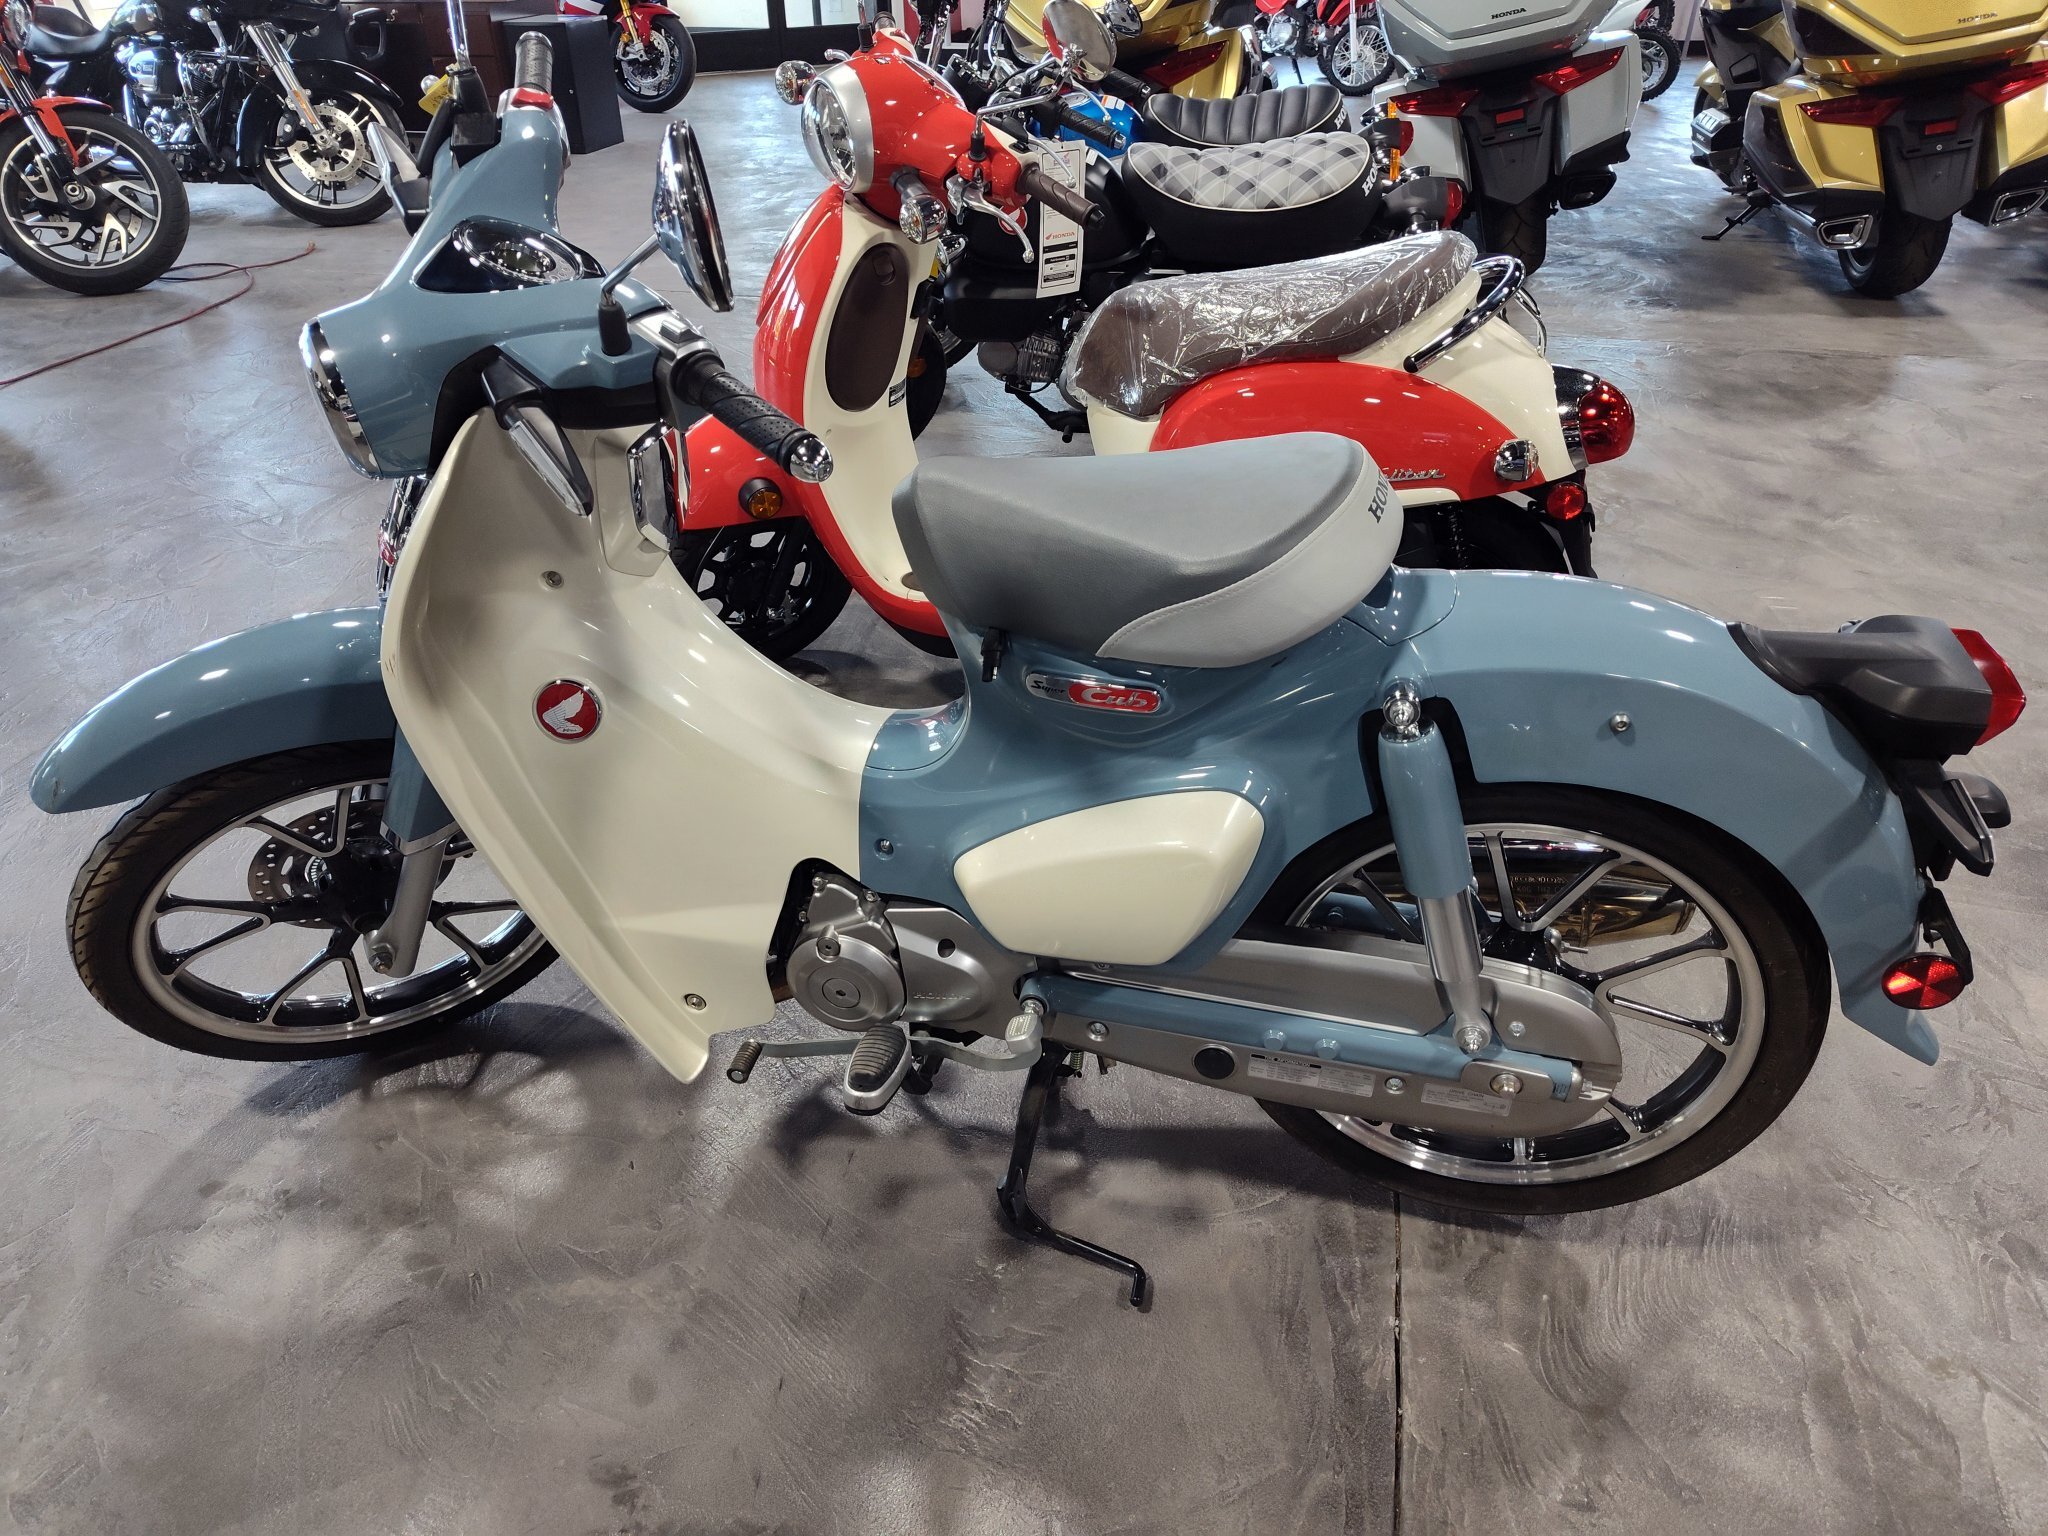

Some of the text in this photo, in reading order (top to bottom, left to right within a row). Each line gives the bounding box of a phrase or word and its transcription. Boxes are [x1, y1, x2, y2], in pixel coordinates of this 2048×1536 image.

[1491, 7, 1527, 19] HONDA
[1053, 231, 1075, 240] HONDA
[1030, 680, 1148, 707] Super Cub
